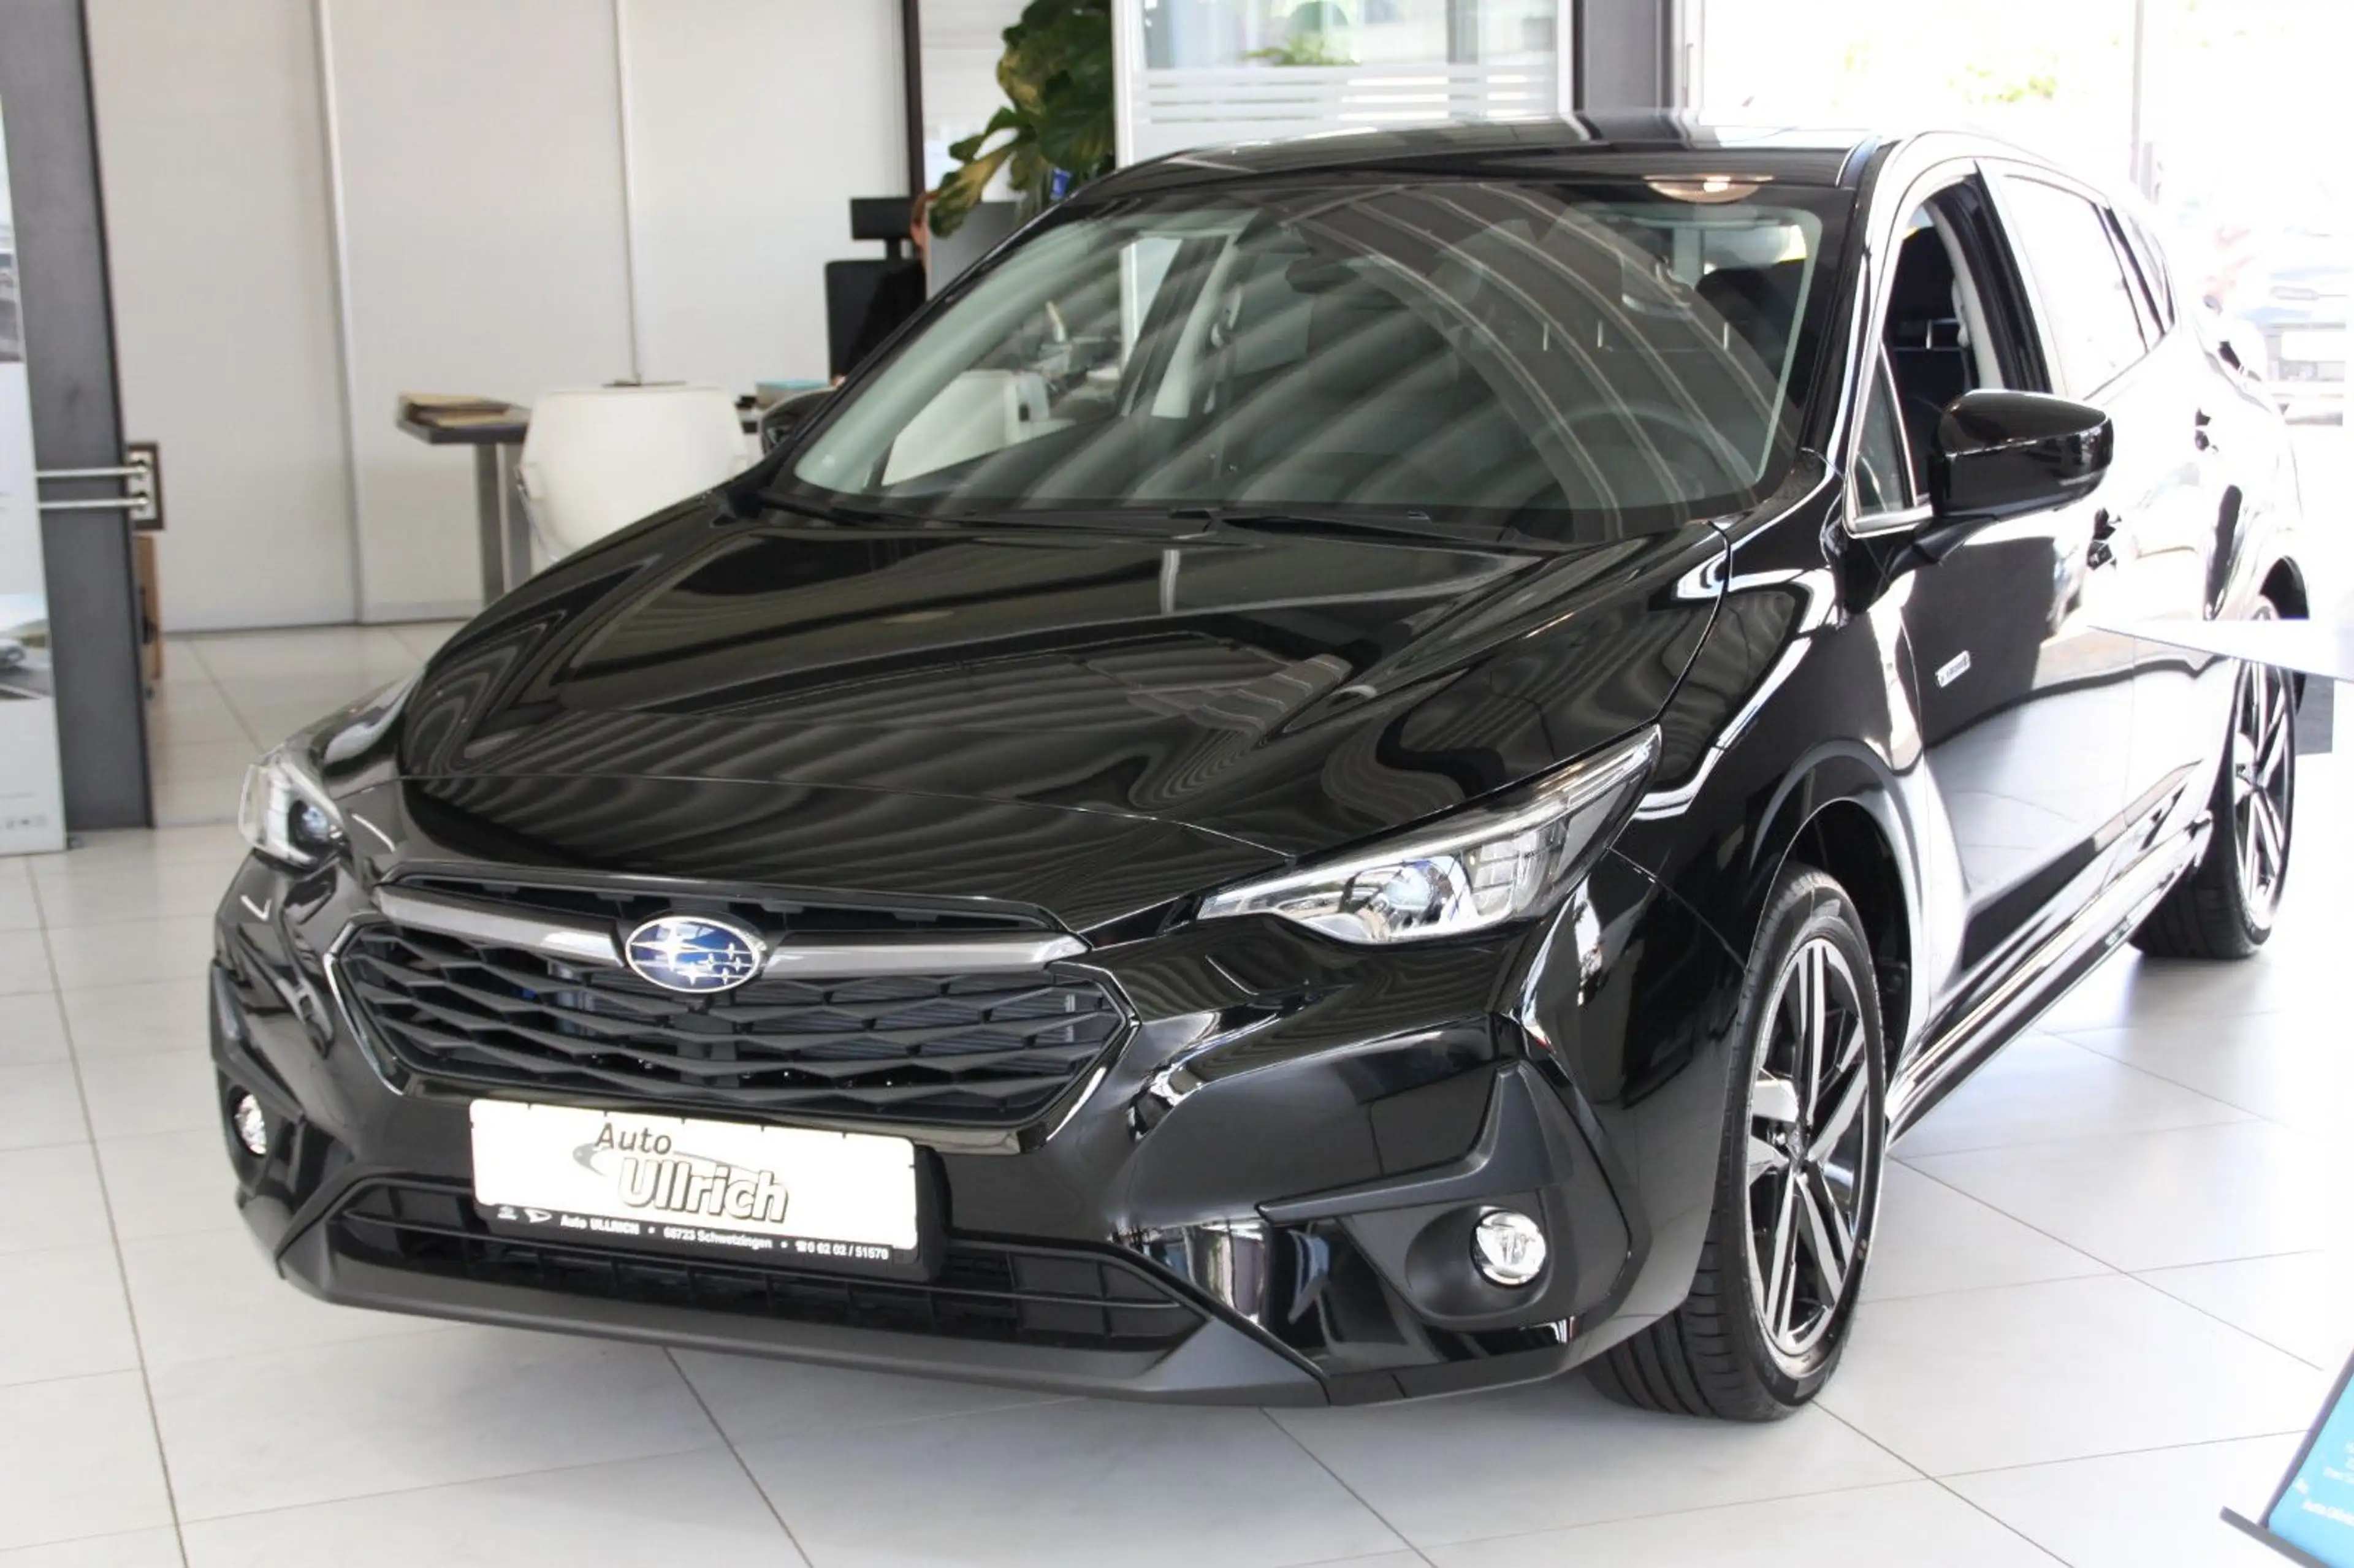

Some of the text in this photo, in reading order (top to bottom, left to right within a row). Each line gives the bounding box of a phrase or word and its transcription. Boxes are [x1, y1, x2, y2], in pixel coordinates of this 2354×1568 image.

[594, 1122, 672, 1155] Auto
[618, 1157, 789, 1224] Ullrich
[560, 1214, 587, 1230] Auto
